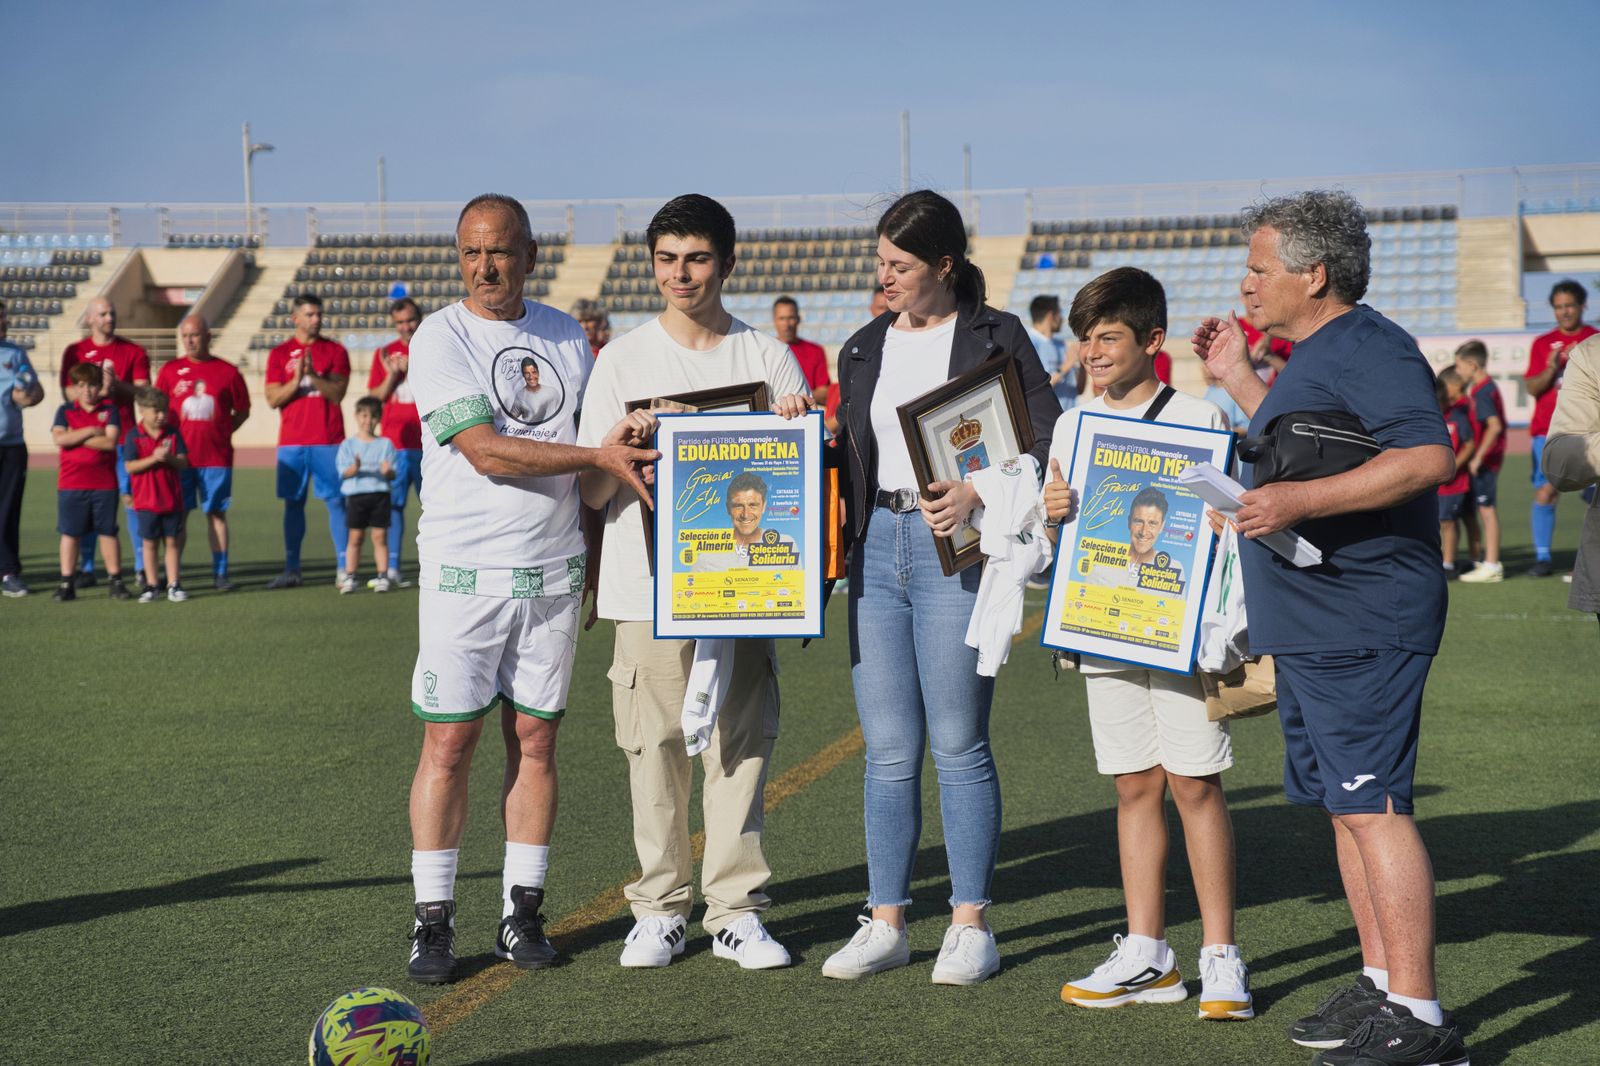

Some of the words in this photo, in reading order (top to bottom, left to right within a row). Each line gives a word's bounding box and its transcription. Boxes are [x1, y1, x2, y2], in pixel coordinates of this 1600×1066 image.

[500, 424, 550, 439] Homenaje
[551, 430, 557, 438] a
[677, 438, 701, 446] Partido
[738, 436, 772, 444] Homenaje
[678, 444, 750, 461] EDUARDO
[754, 442, 799, 460] MENA
[1097, 441, 1118, 450] Partido
[1126, 444, 1149, 455] FÚTBOL
[1151, 448, 1183, 460] Homenaje
[1094, 447, 1161, 474] EDUARDO
[1162, 457, 1196, 477] ME
[676, 467, 735, 510] Gracias
[1083, 474, 1142, 517] Gracias
[682, 487, 720, 523] Edu
[1086, 497, 1125, 531] Edu
[680, 531, 718, 541] Selección
[721, 531, 731, 540] de
[696, 541, 734, 551] Almería
[749, 545, 790, 555] Selección
[1080, 540, 1116, 553] Selección
[1118, 546, 1127, 556] de
[752, 554, 796, 565] Solidaria
[1093, 552, 1128, 567] Almería
[1140, 565, 1177, 580] Selección
[1141, 576, 1181, 593] Solidaria
[1386, 1037, 1403, 1048] FILA
